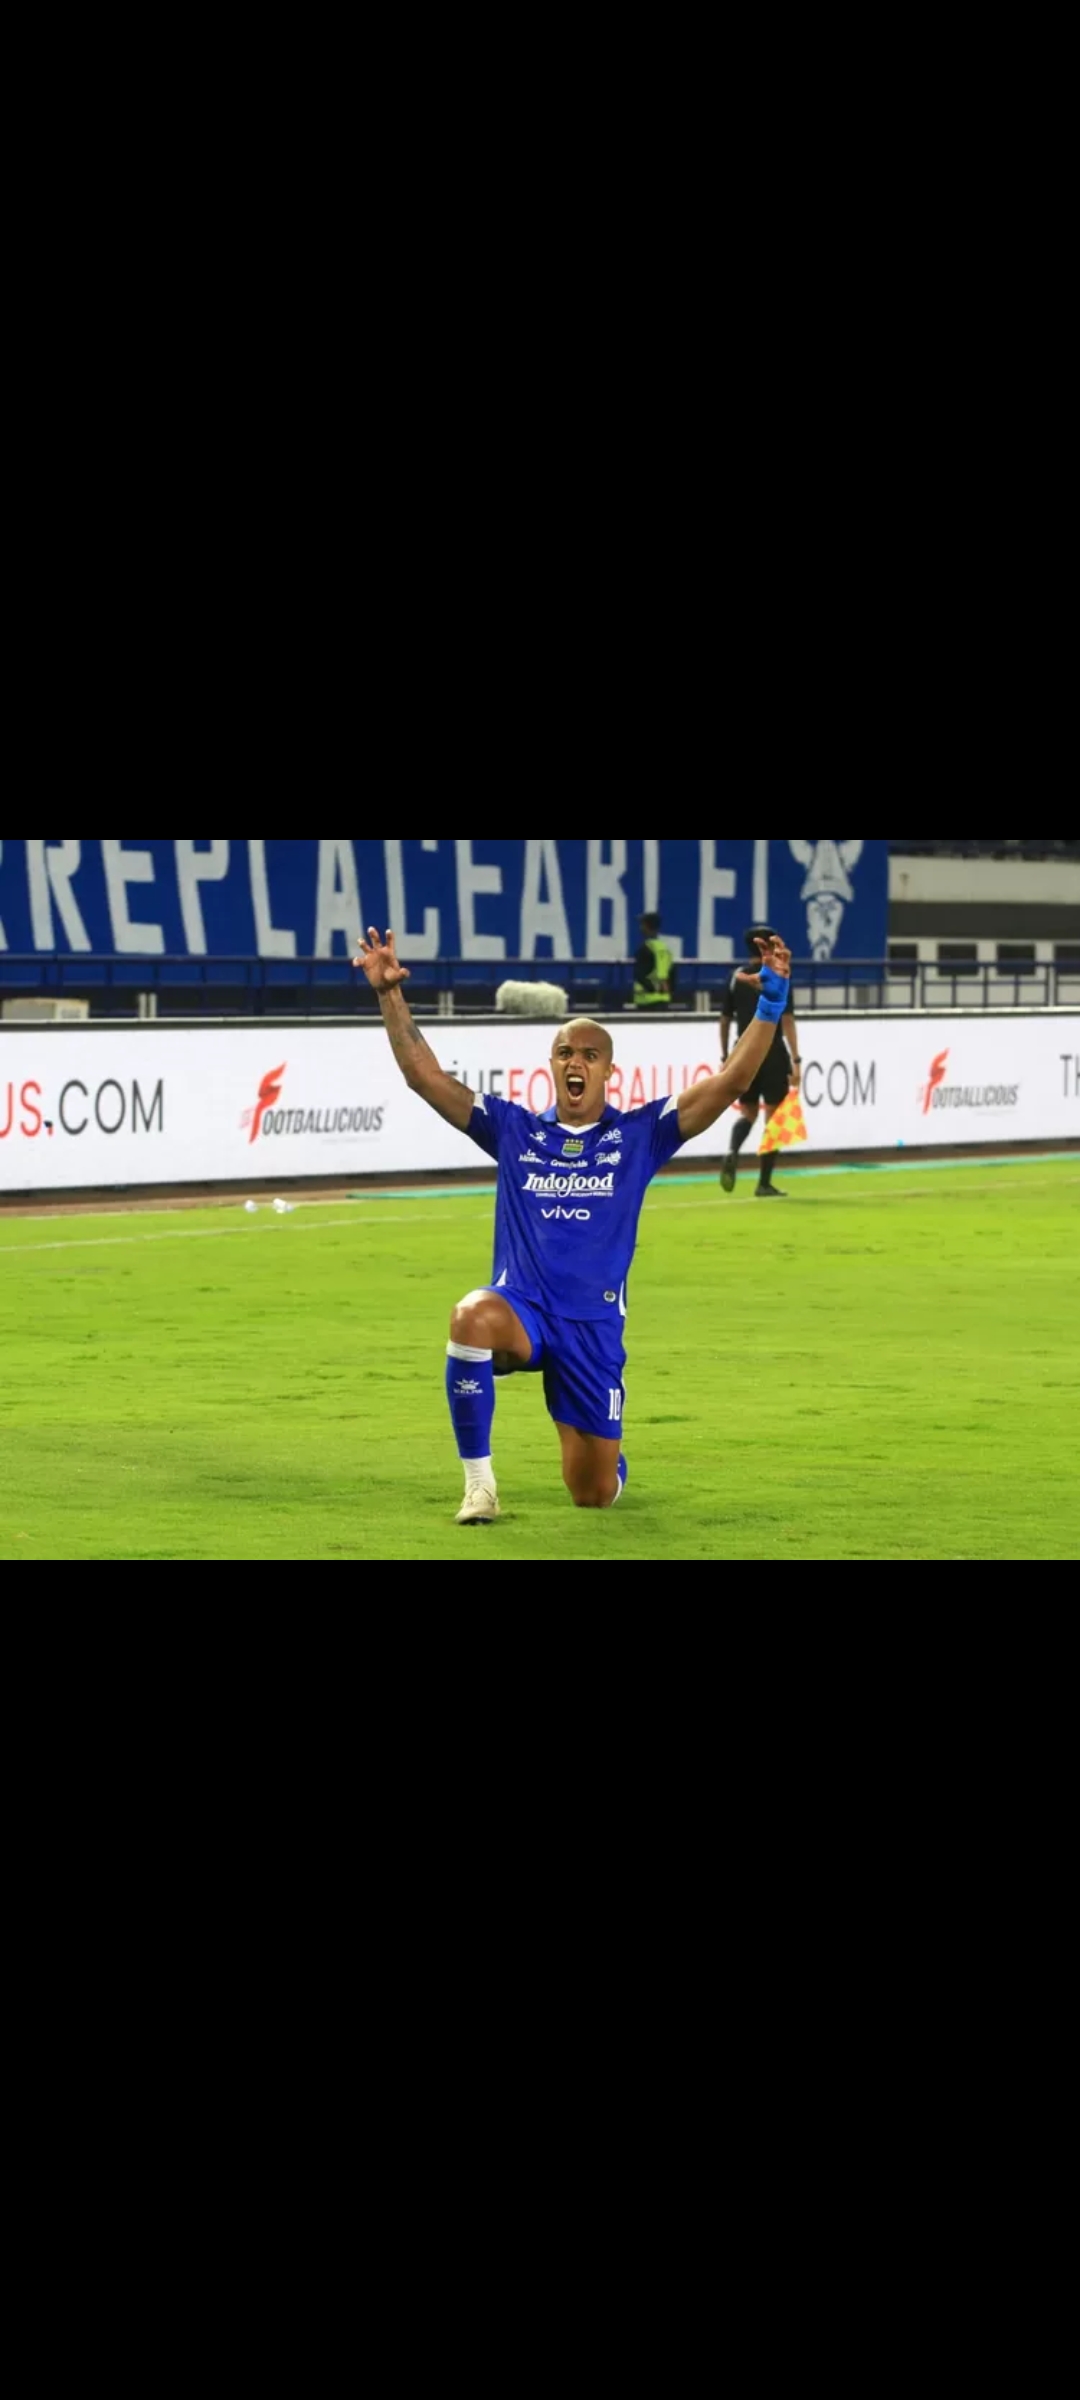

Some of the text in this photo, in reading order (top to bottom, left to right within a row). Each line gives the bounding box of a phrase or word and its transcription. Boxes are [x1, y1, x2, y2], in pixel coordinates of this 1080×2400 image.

[0, 840, 768, 963] REPLACEABLE!
[249, 1061, 384, 1144] FOOTBALLICIOUS
[522, 1172, 614, 1197] Indofood
[541, 1205, 591, 1220] vivo
[609, 1388, 621, 1420] 10
